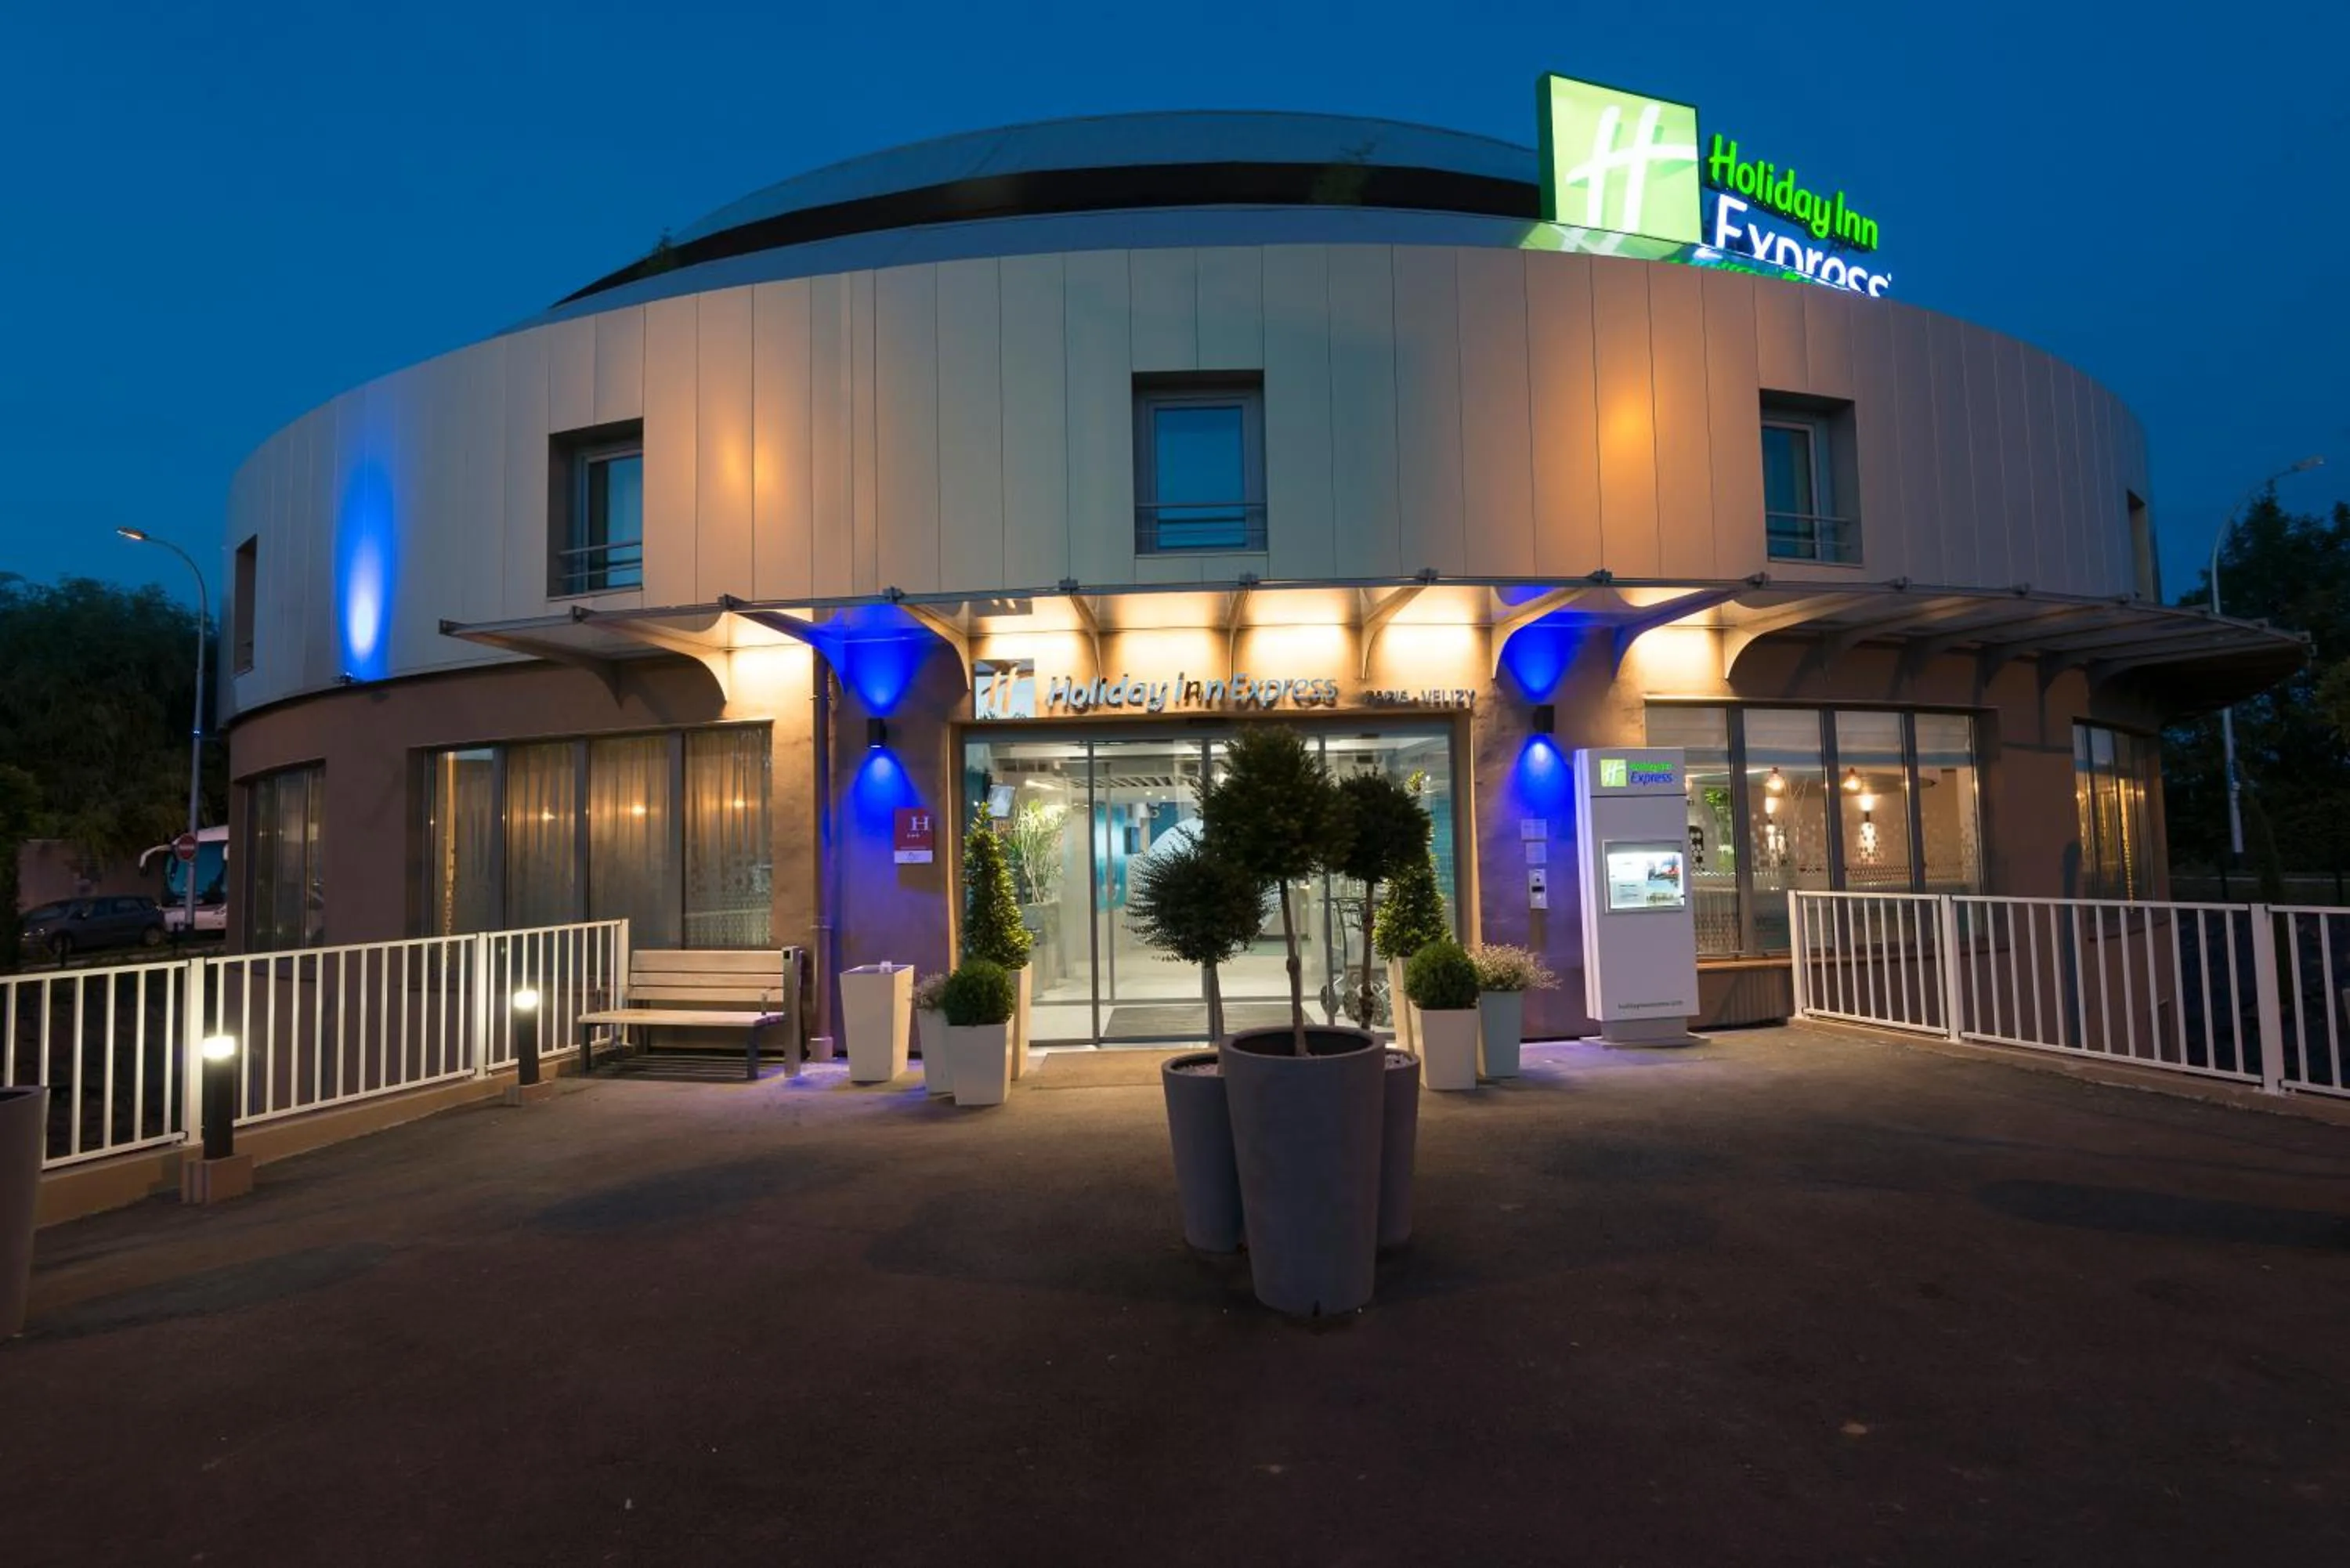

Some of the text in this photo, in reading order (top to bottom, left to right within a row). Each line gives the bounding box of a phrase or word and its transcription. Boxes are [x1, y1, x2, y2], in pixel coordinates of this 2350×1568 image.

[1708, 132, 1878, 251] Holiday Inn
[1046, 671, 1338, 714] Holiday Inn Express
[1421, 689, 1476, 708] VELIZY
[912, 816, 928, 830] H
